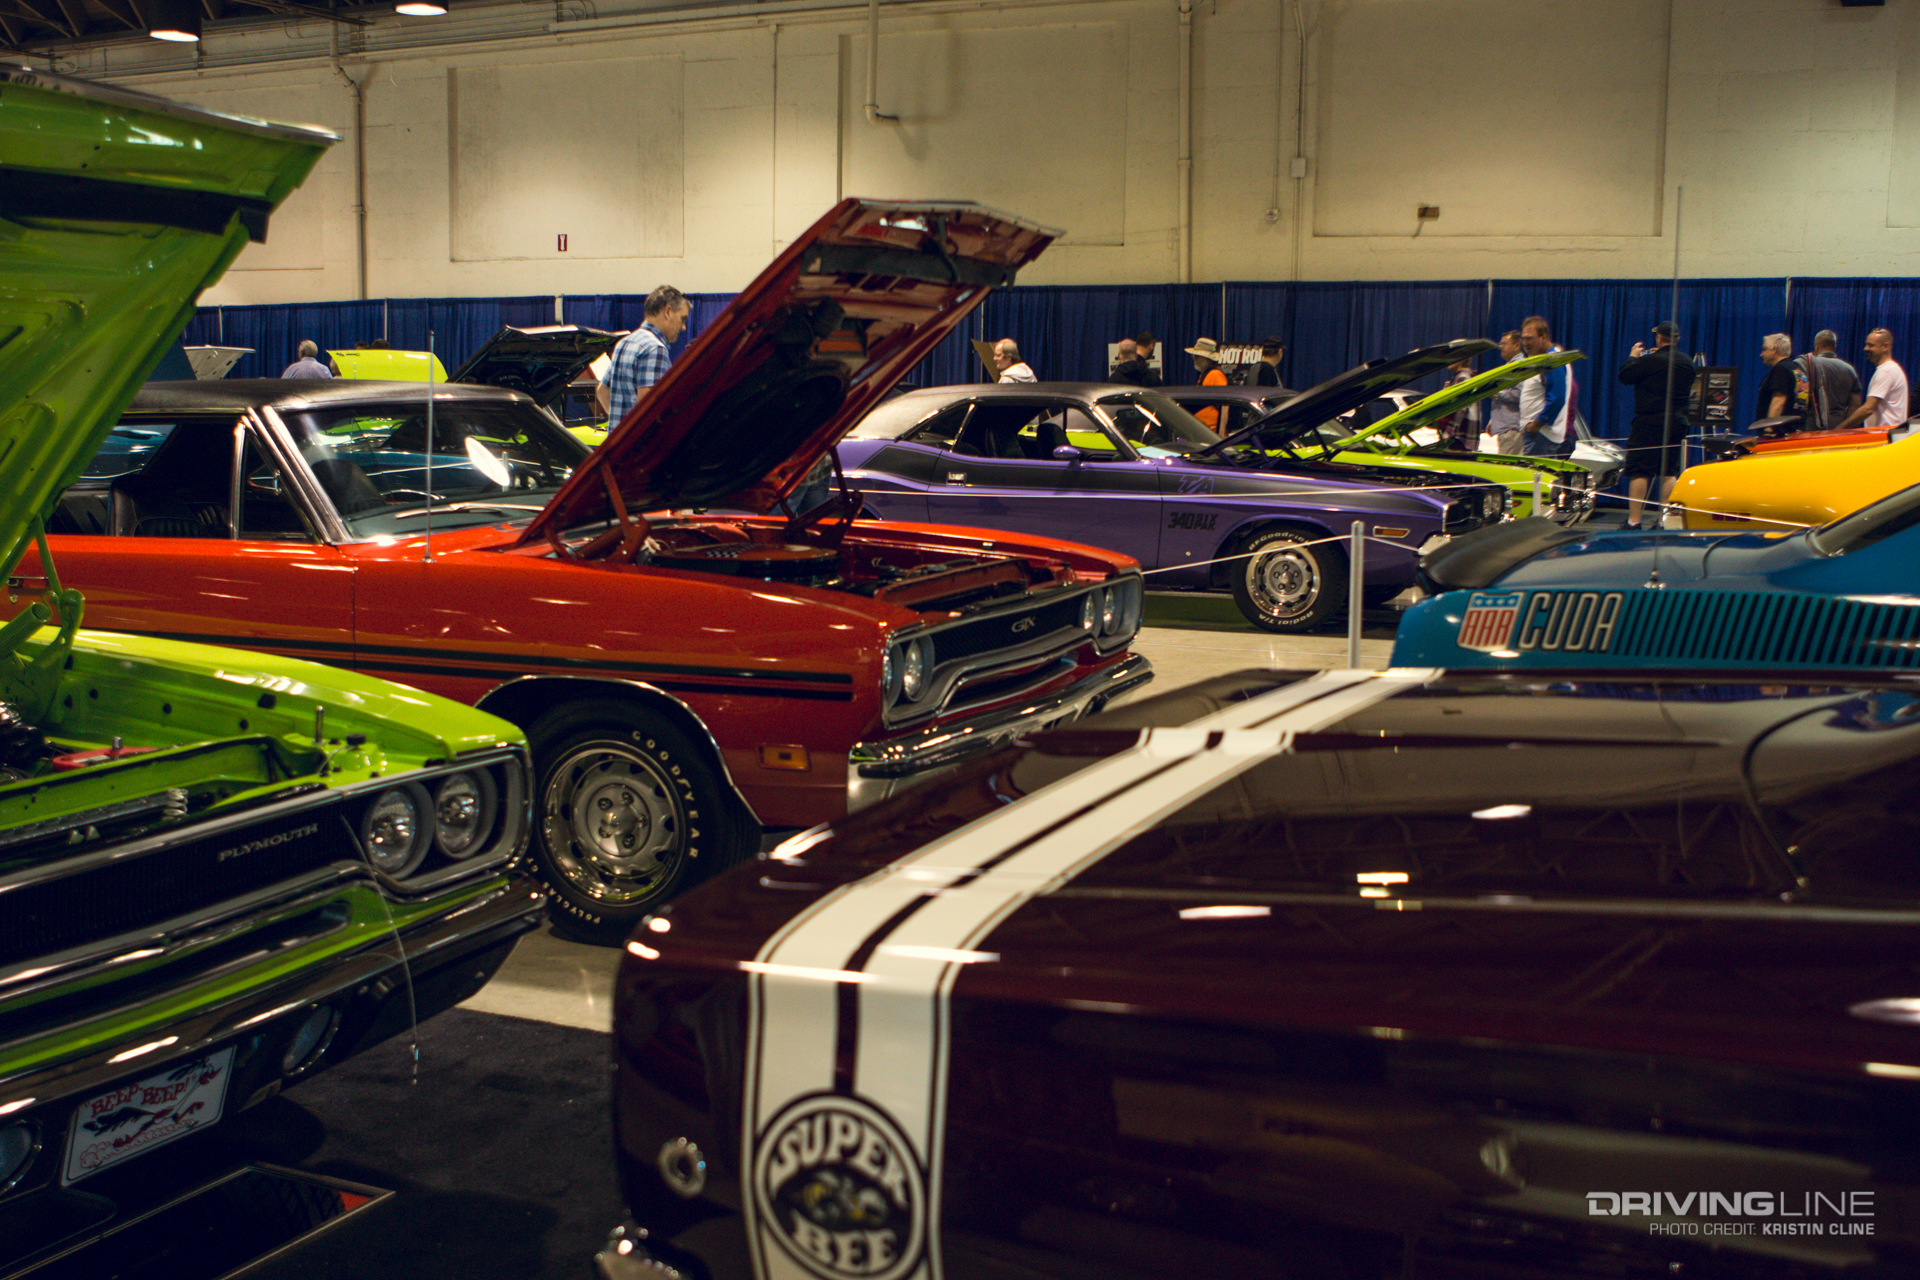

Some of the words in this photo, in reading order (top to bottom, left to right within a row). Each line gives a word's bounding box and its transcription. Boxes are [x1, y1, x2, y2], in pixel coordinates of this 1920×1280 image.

[1218, 348, 1242, 364] HOT
[1168, 512, 1195, 530] 340
[1459, 609, 1516, 648] AAR
[1518, 592, 1625, 651] CUDA
[218, 822, 319, 862] PLYMOUTH
[768, 1111, 910, 1208] SUPER
[791, 1208, 898, 1275] BEE
